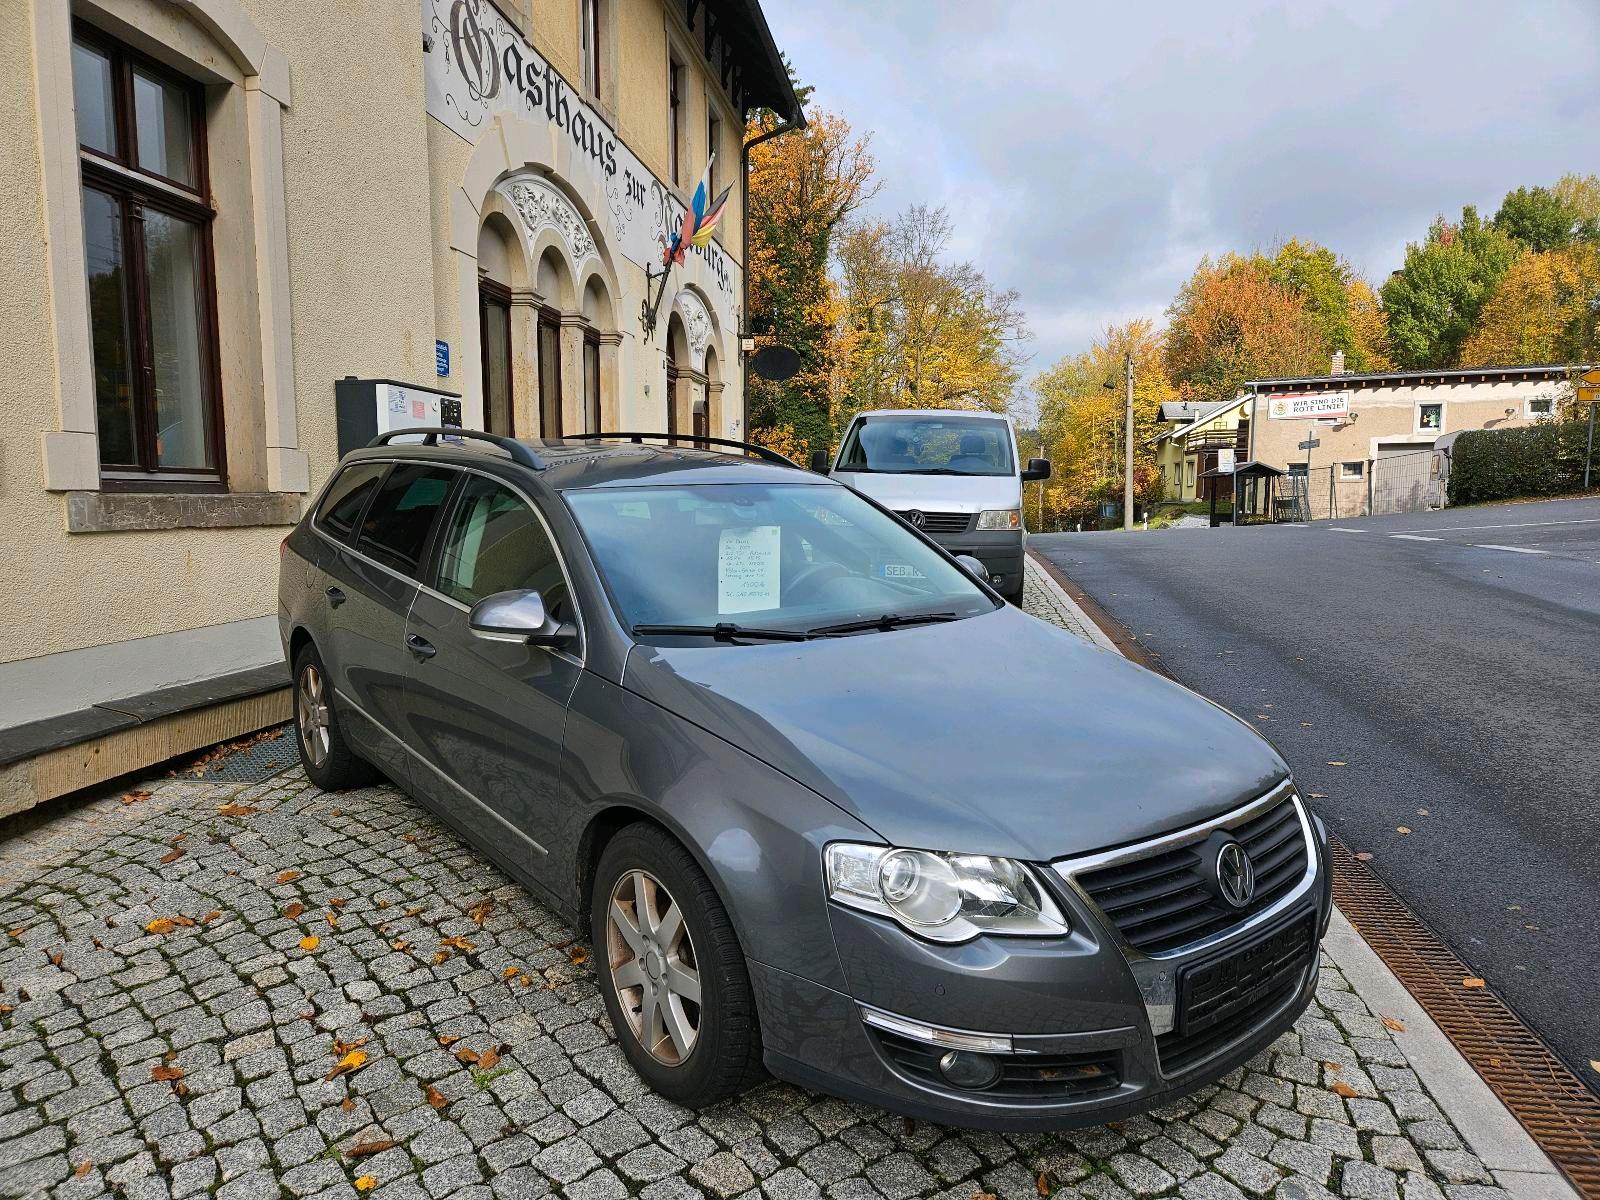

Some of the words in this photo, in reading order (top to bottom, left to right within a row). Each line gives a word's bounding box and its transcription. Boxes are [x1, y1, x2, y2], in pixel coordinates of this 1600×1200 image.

[448, 0, 617, 177] Gasthaus
[625, 168, 647, 209] zur
[886, 566, 906, 576] SEB
